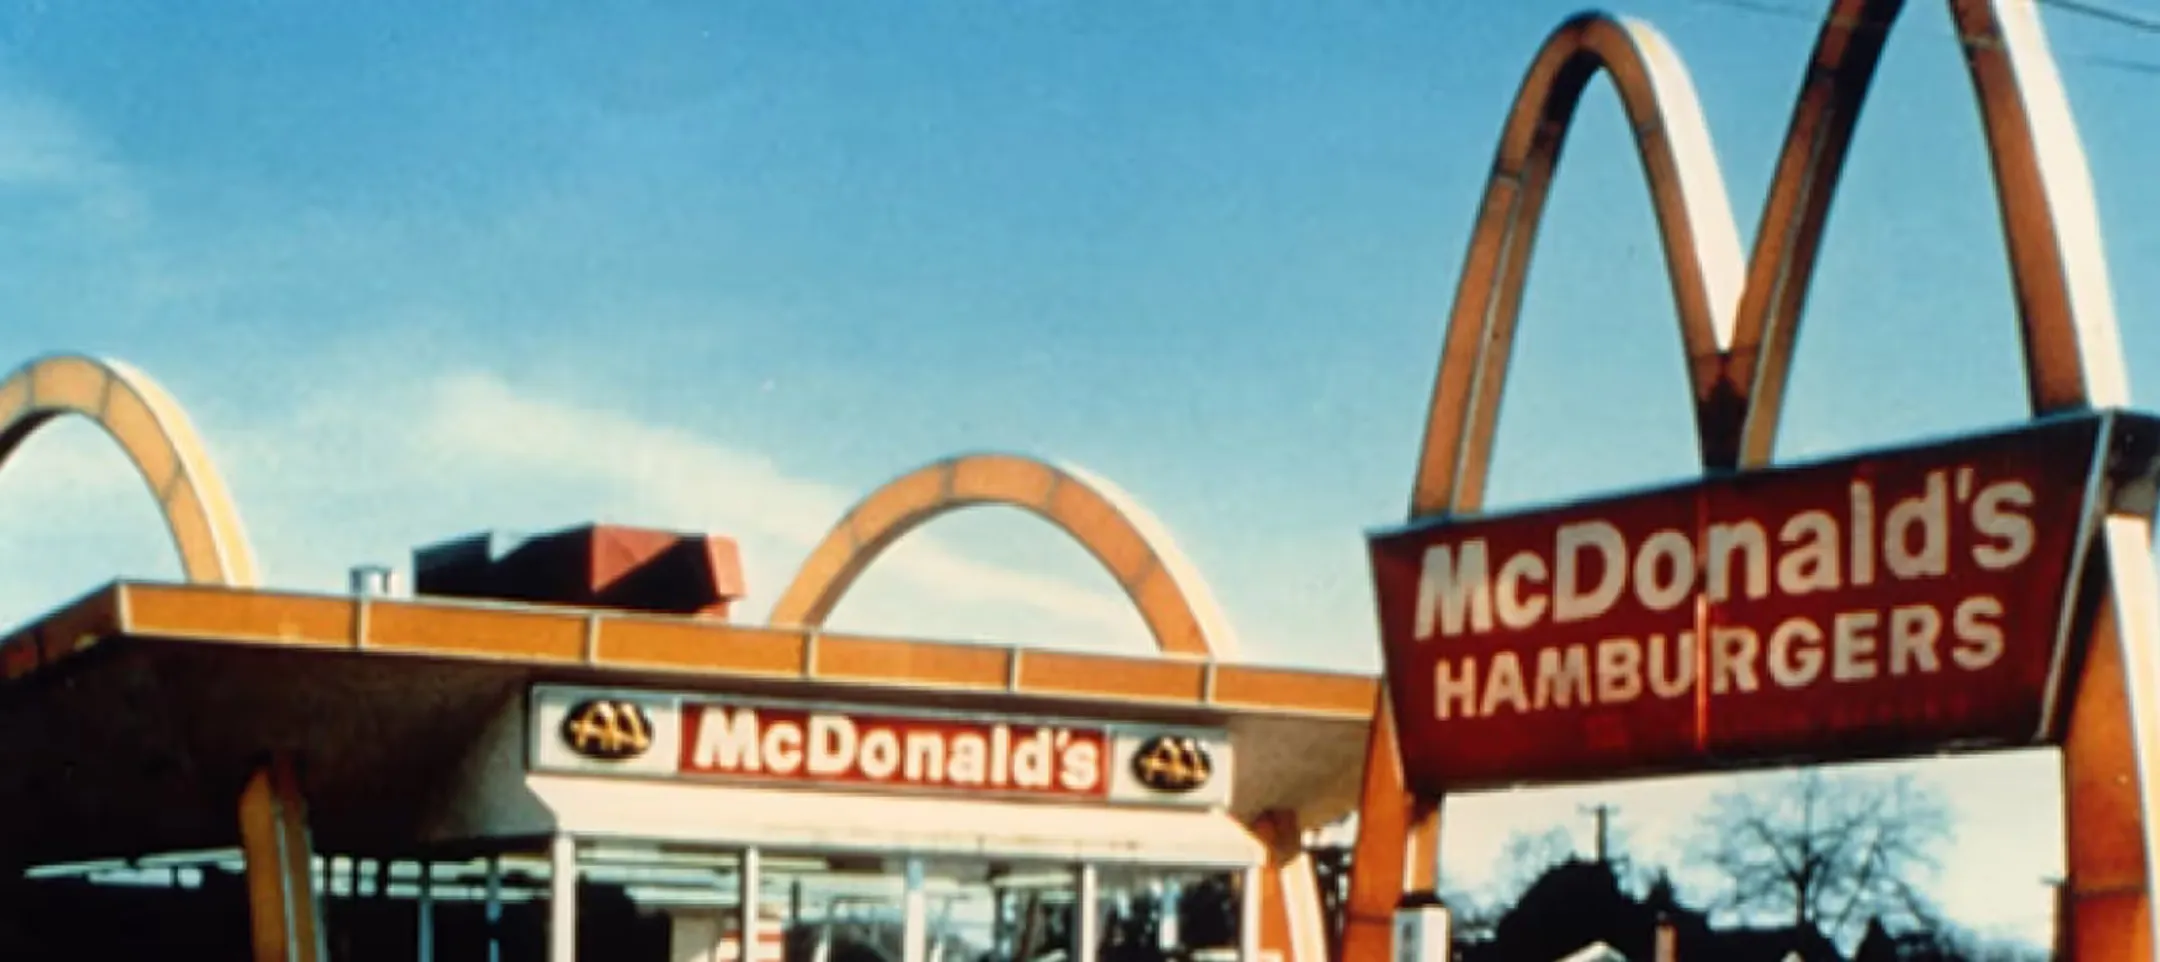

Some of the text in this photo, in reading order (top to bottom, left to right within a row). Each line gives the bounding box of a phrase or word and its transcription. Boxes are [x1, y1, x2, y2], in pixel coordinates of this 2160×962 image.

[1415, 467, 2034, 640] McDonald's
[1435, 596, 2004, 719] HAMBURGERS
[693, 707, 1100, 791] McDonald's
